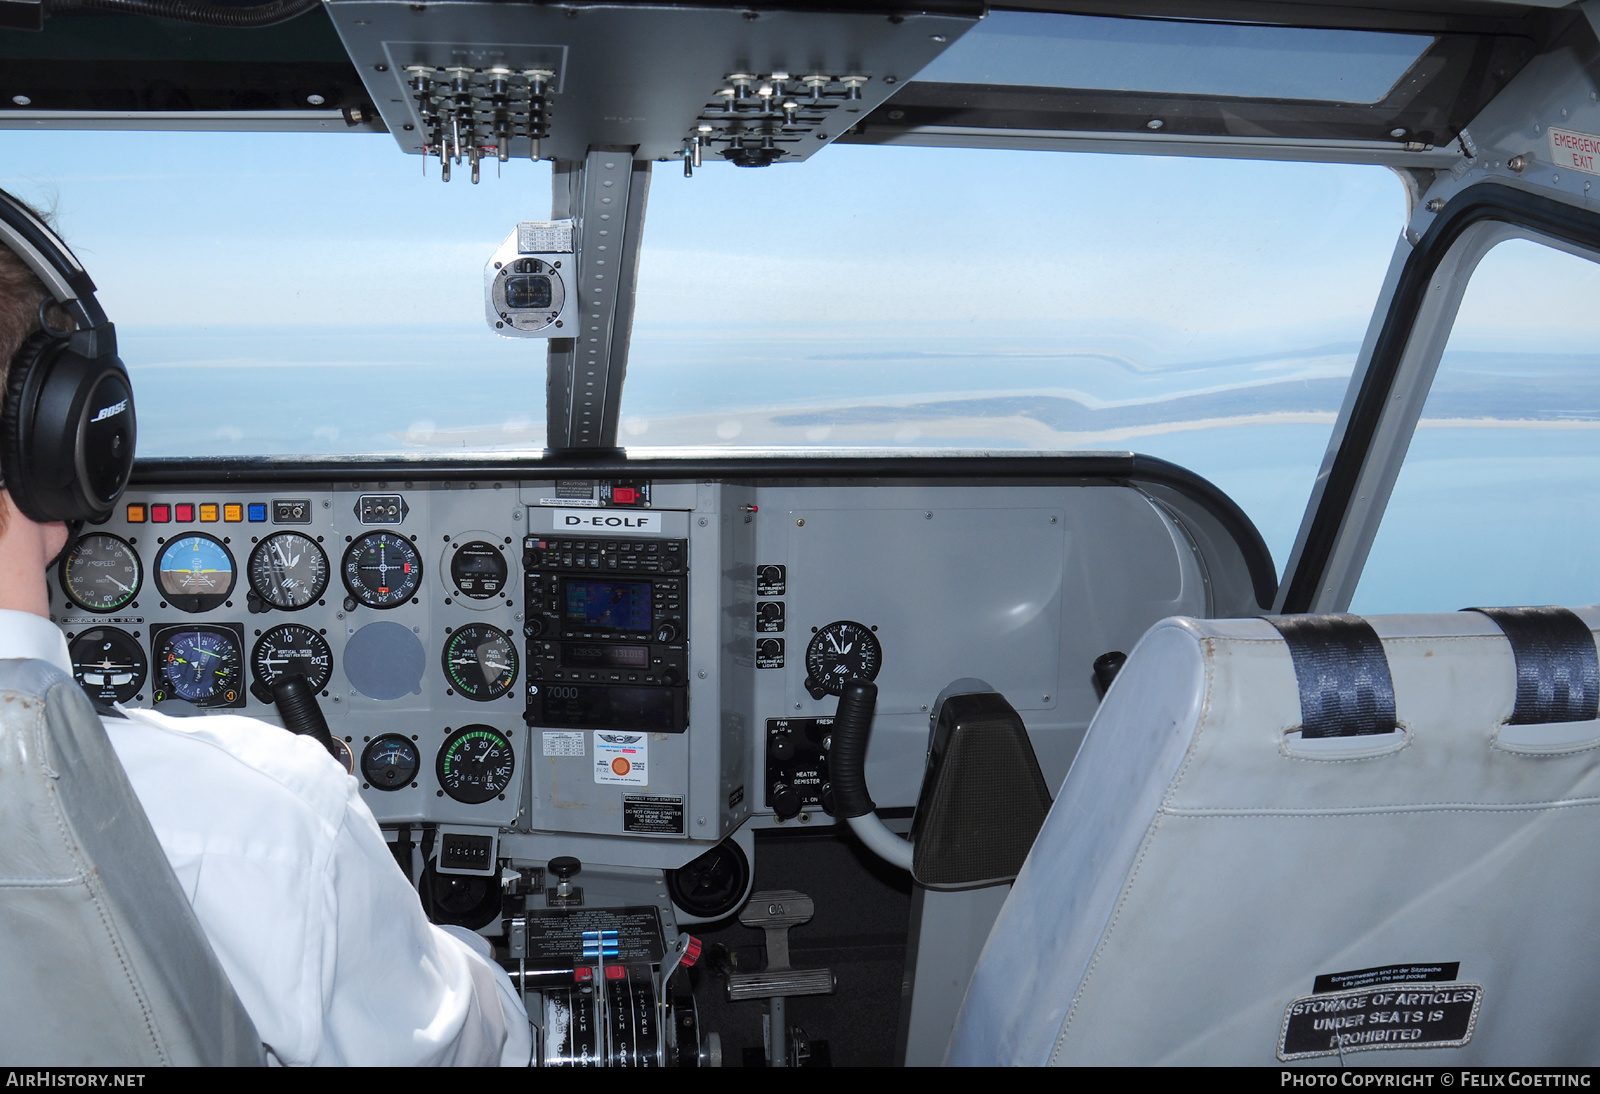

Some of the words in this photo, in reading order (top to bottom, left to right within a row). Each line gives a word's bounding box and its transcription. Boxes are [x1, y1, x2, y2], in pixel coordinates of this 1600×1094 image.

[1573, 154, 1593, 170] EXIT
[91, 399, 128, 422] BOSE
[566, 516, 649, 527] D-EOLF
[407, 549, 414, 558] 12
[348, 564, 356, 572] 33
[411, 565, 418, 574] 15
[265, 578, 270, 586] 7
[352, 579, 360, 588] 30
[394, 592, 403, 600] 21
[546, 686, 578, 698] 7000
[478, 740, 488, 748] 20
[454, 770, 459, 778] 5
[486, 782, 494, 790] 35
[1331, 972, 1378, 982] Schwimmwesten
[1354, 978, 1374, 986] jackets
[1292, 996, 1368, 1016] STOWAGE
[1372, 994, 1394, 1006] OF
[1396, 990, 1474, 1006] ARTICLES
[638, 990, 648, 1034] MIXTURE
[1314, 1014, 1365, 1030] UNDER
[1369, 1010, 1424, 1024] SEATS
[1428, 1010, 1444, 1022] IS
[1329, 1028, 1422, 1048] PROHIBITED
